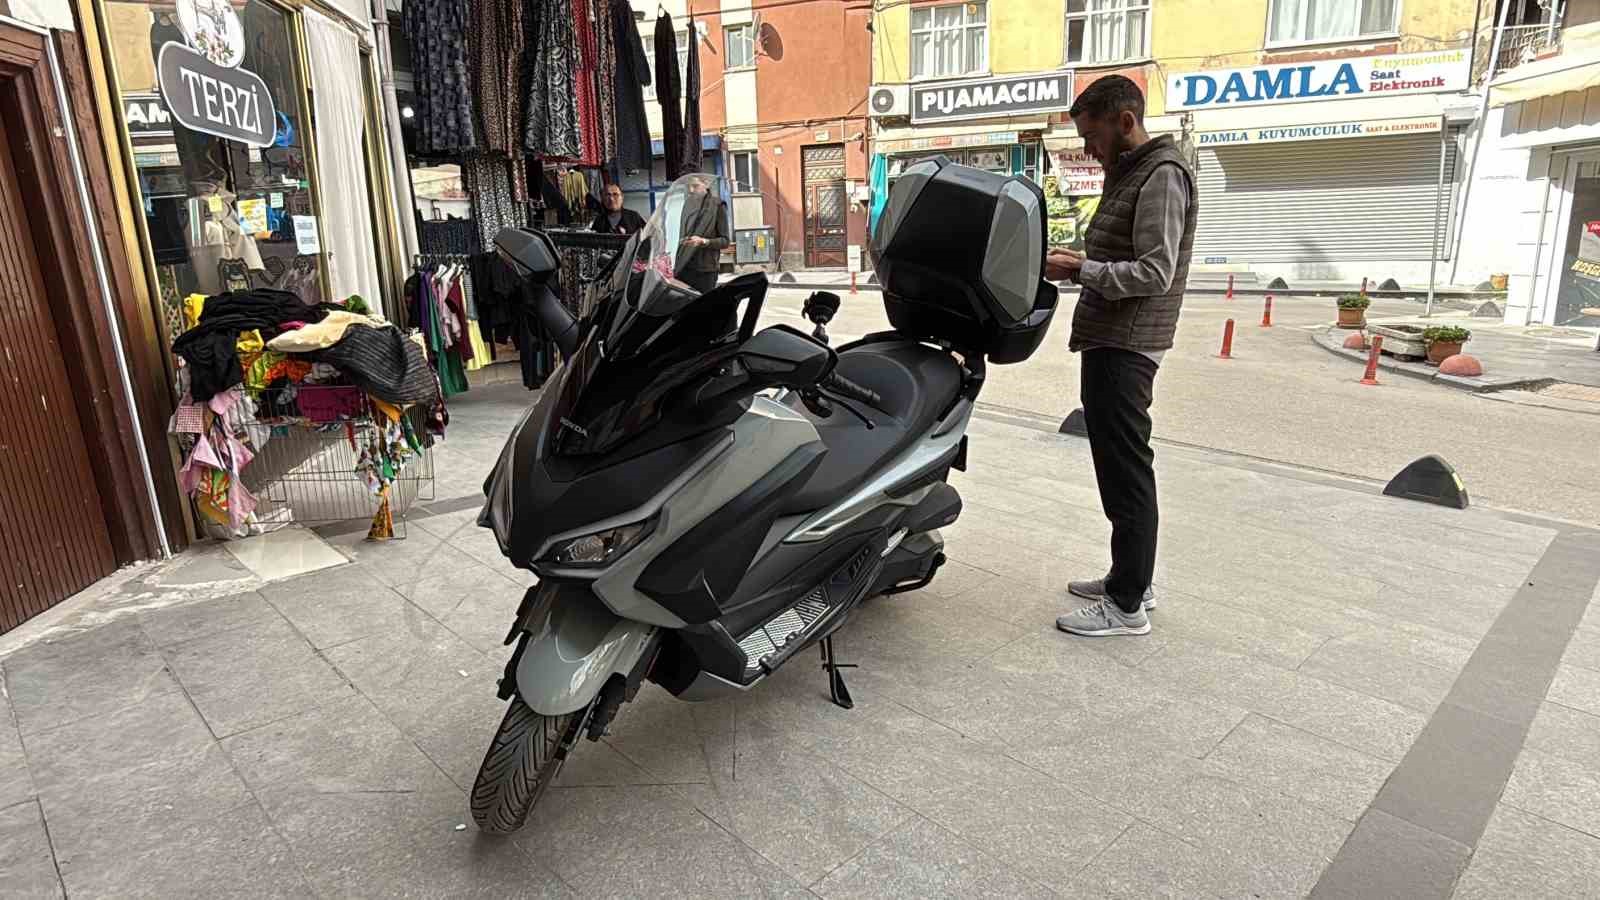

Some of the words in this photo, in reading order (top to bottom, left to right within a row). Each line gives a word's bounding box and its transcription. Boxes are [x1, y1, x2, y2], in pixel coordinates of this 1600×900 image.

[1183, 63, 1363, 106] DAMLA
[1369, 77, 1446, 92] Elektronik
[1370, 69, 1401, 80] Saat
[180, 66, 263, 136] TERZİ
[921, 80, 1060, 113] PIJAMACIM
[1199, 131, 1249, 144] DAMLA
[1257, 123, 1364, 140] KUYUMCULUK
[1365, 125, 1384, 133] SAAT
